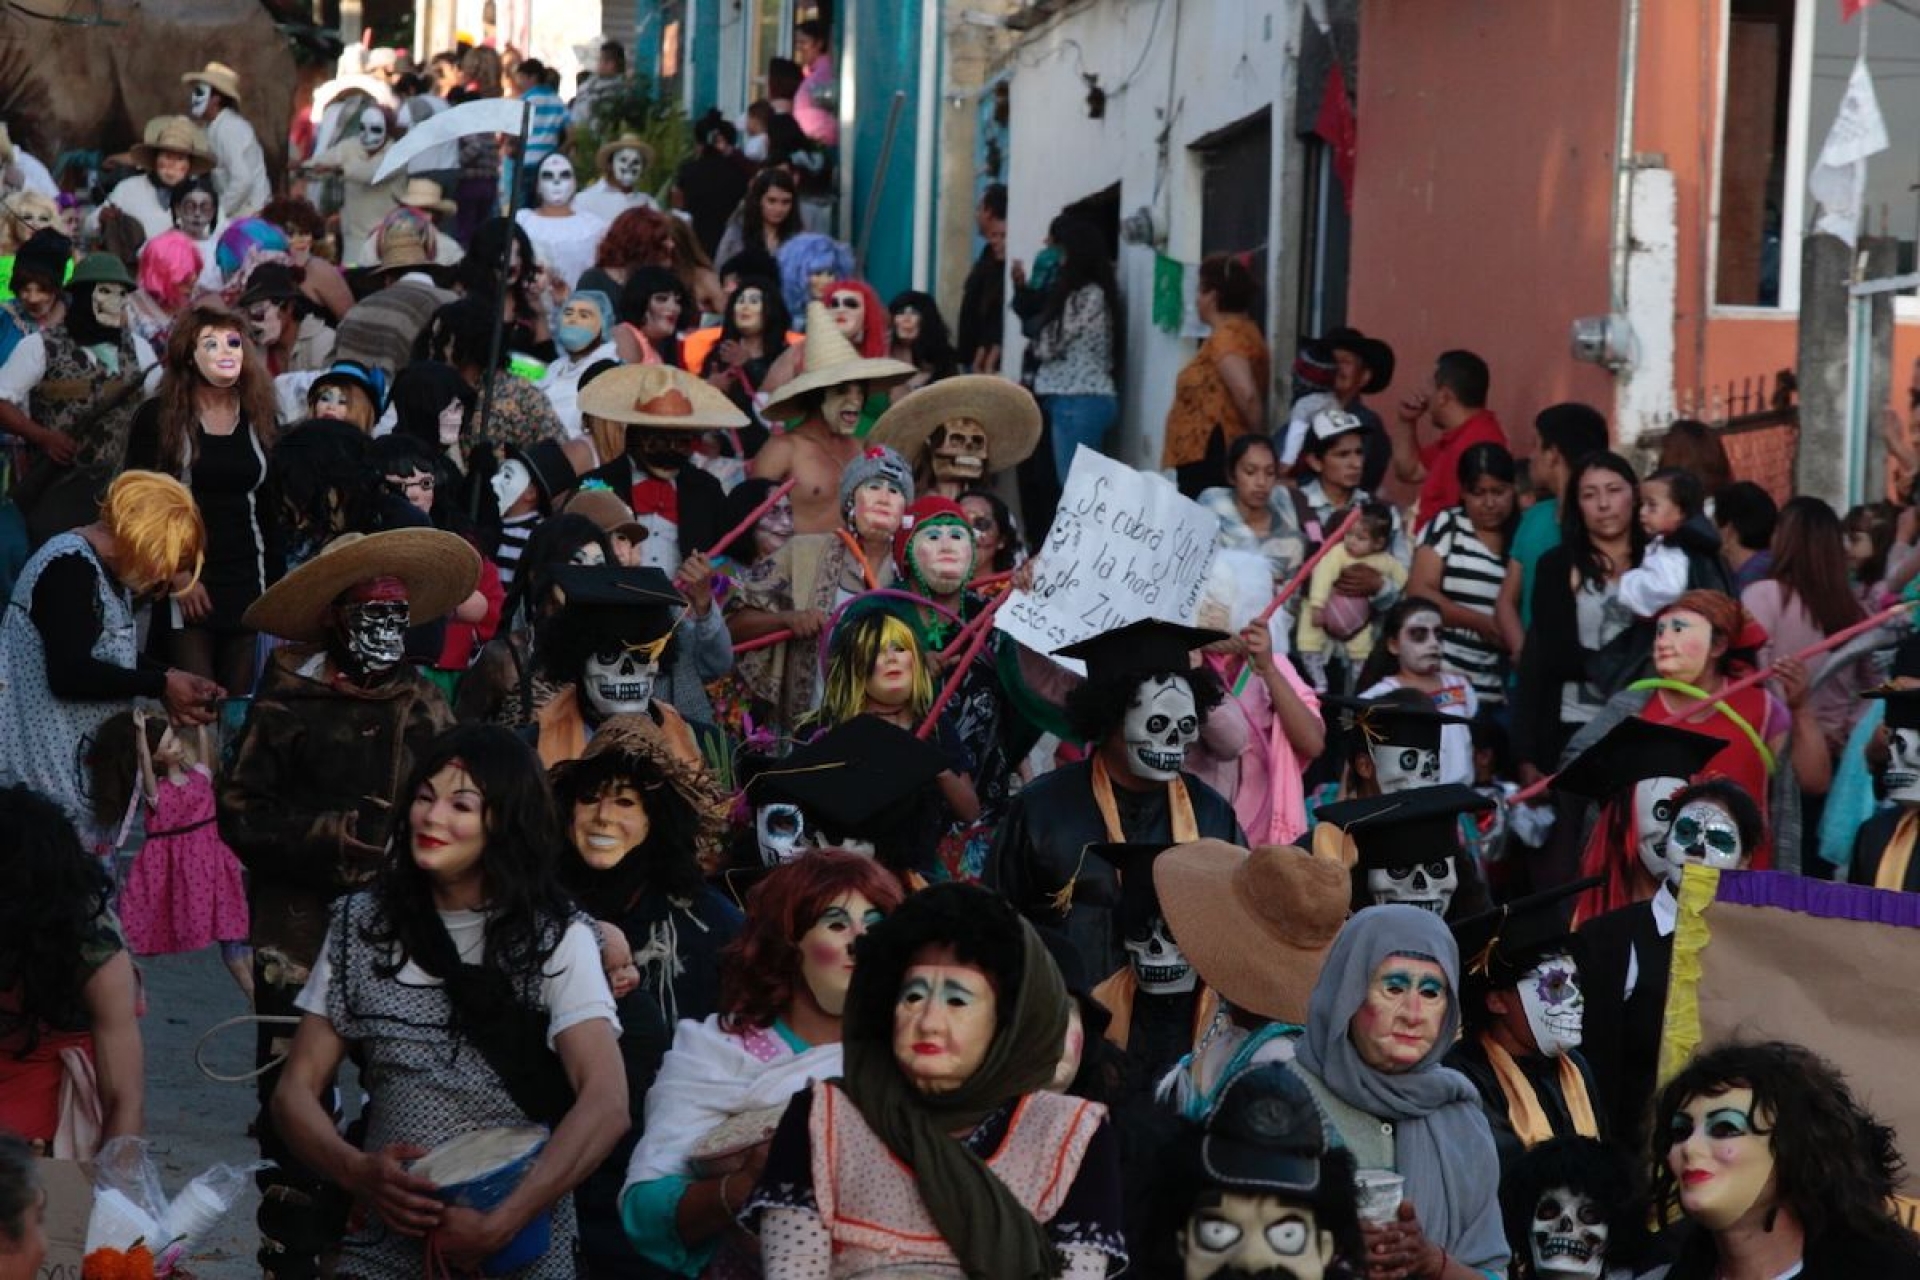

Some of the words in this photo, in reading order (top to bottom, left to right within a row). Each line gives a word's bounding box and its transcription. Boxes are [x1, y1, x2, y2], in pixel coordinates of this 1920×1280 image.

[1077, 476, 1108, 524] Se
[1112, 506, 1164, 551] cobra
[1055, 560, 1080, 590] de
[1093, 542, 1116, 580] la
[1121, 556, 1161, 604] hora
